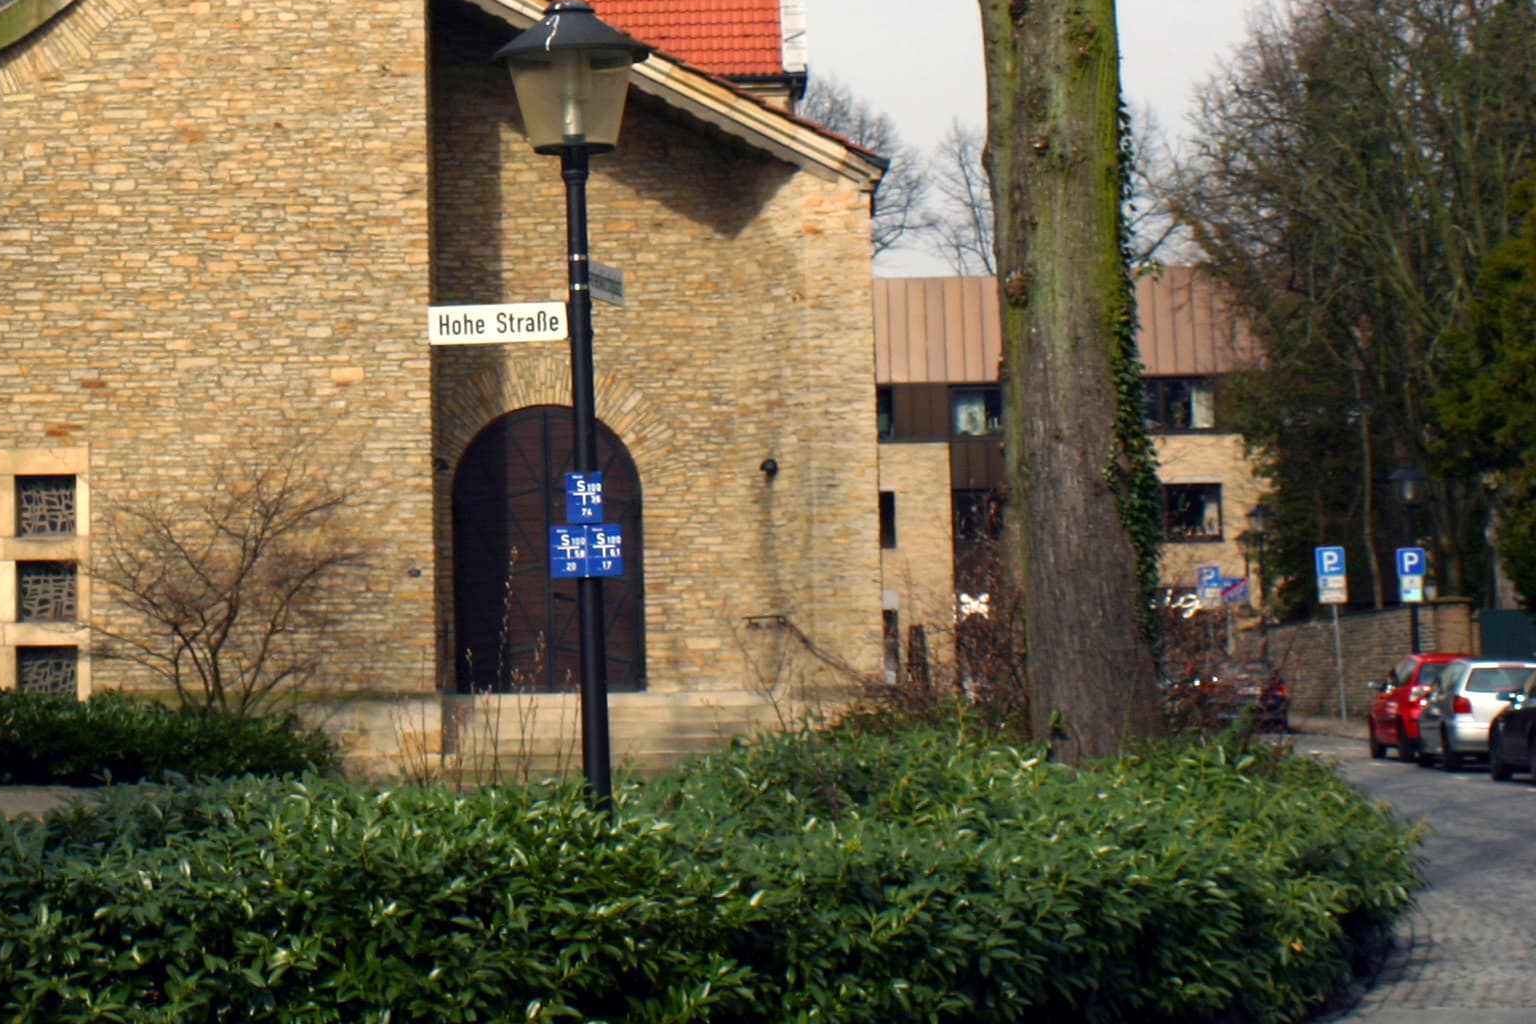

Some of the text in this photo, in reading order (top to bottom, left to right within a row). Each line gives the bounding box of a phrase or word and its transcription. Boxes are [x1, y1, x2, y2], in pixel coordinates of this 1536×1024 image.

[438, 310, 560, 336] Hohe Straße
[1323, 551, 1339, 573] P
[1403, 552, 1419, 573] P
